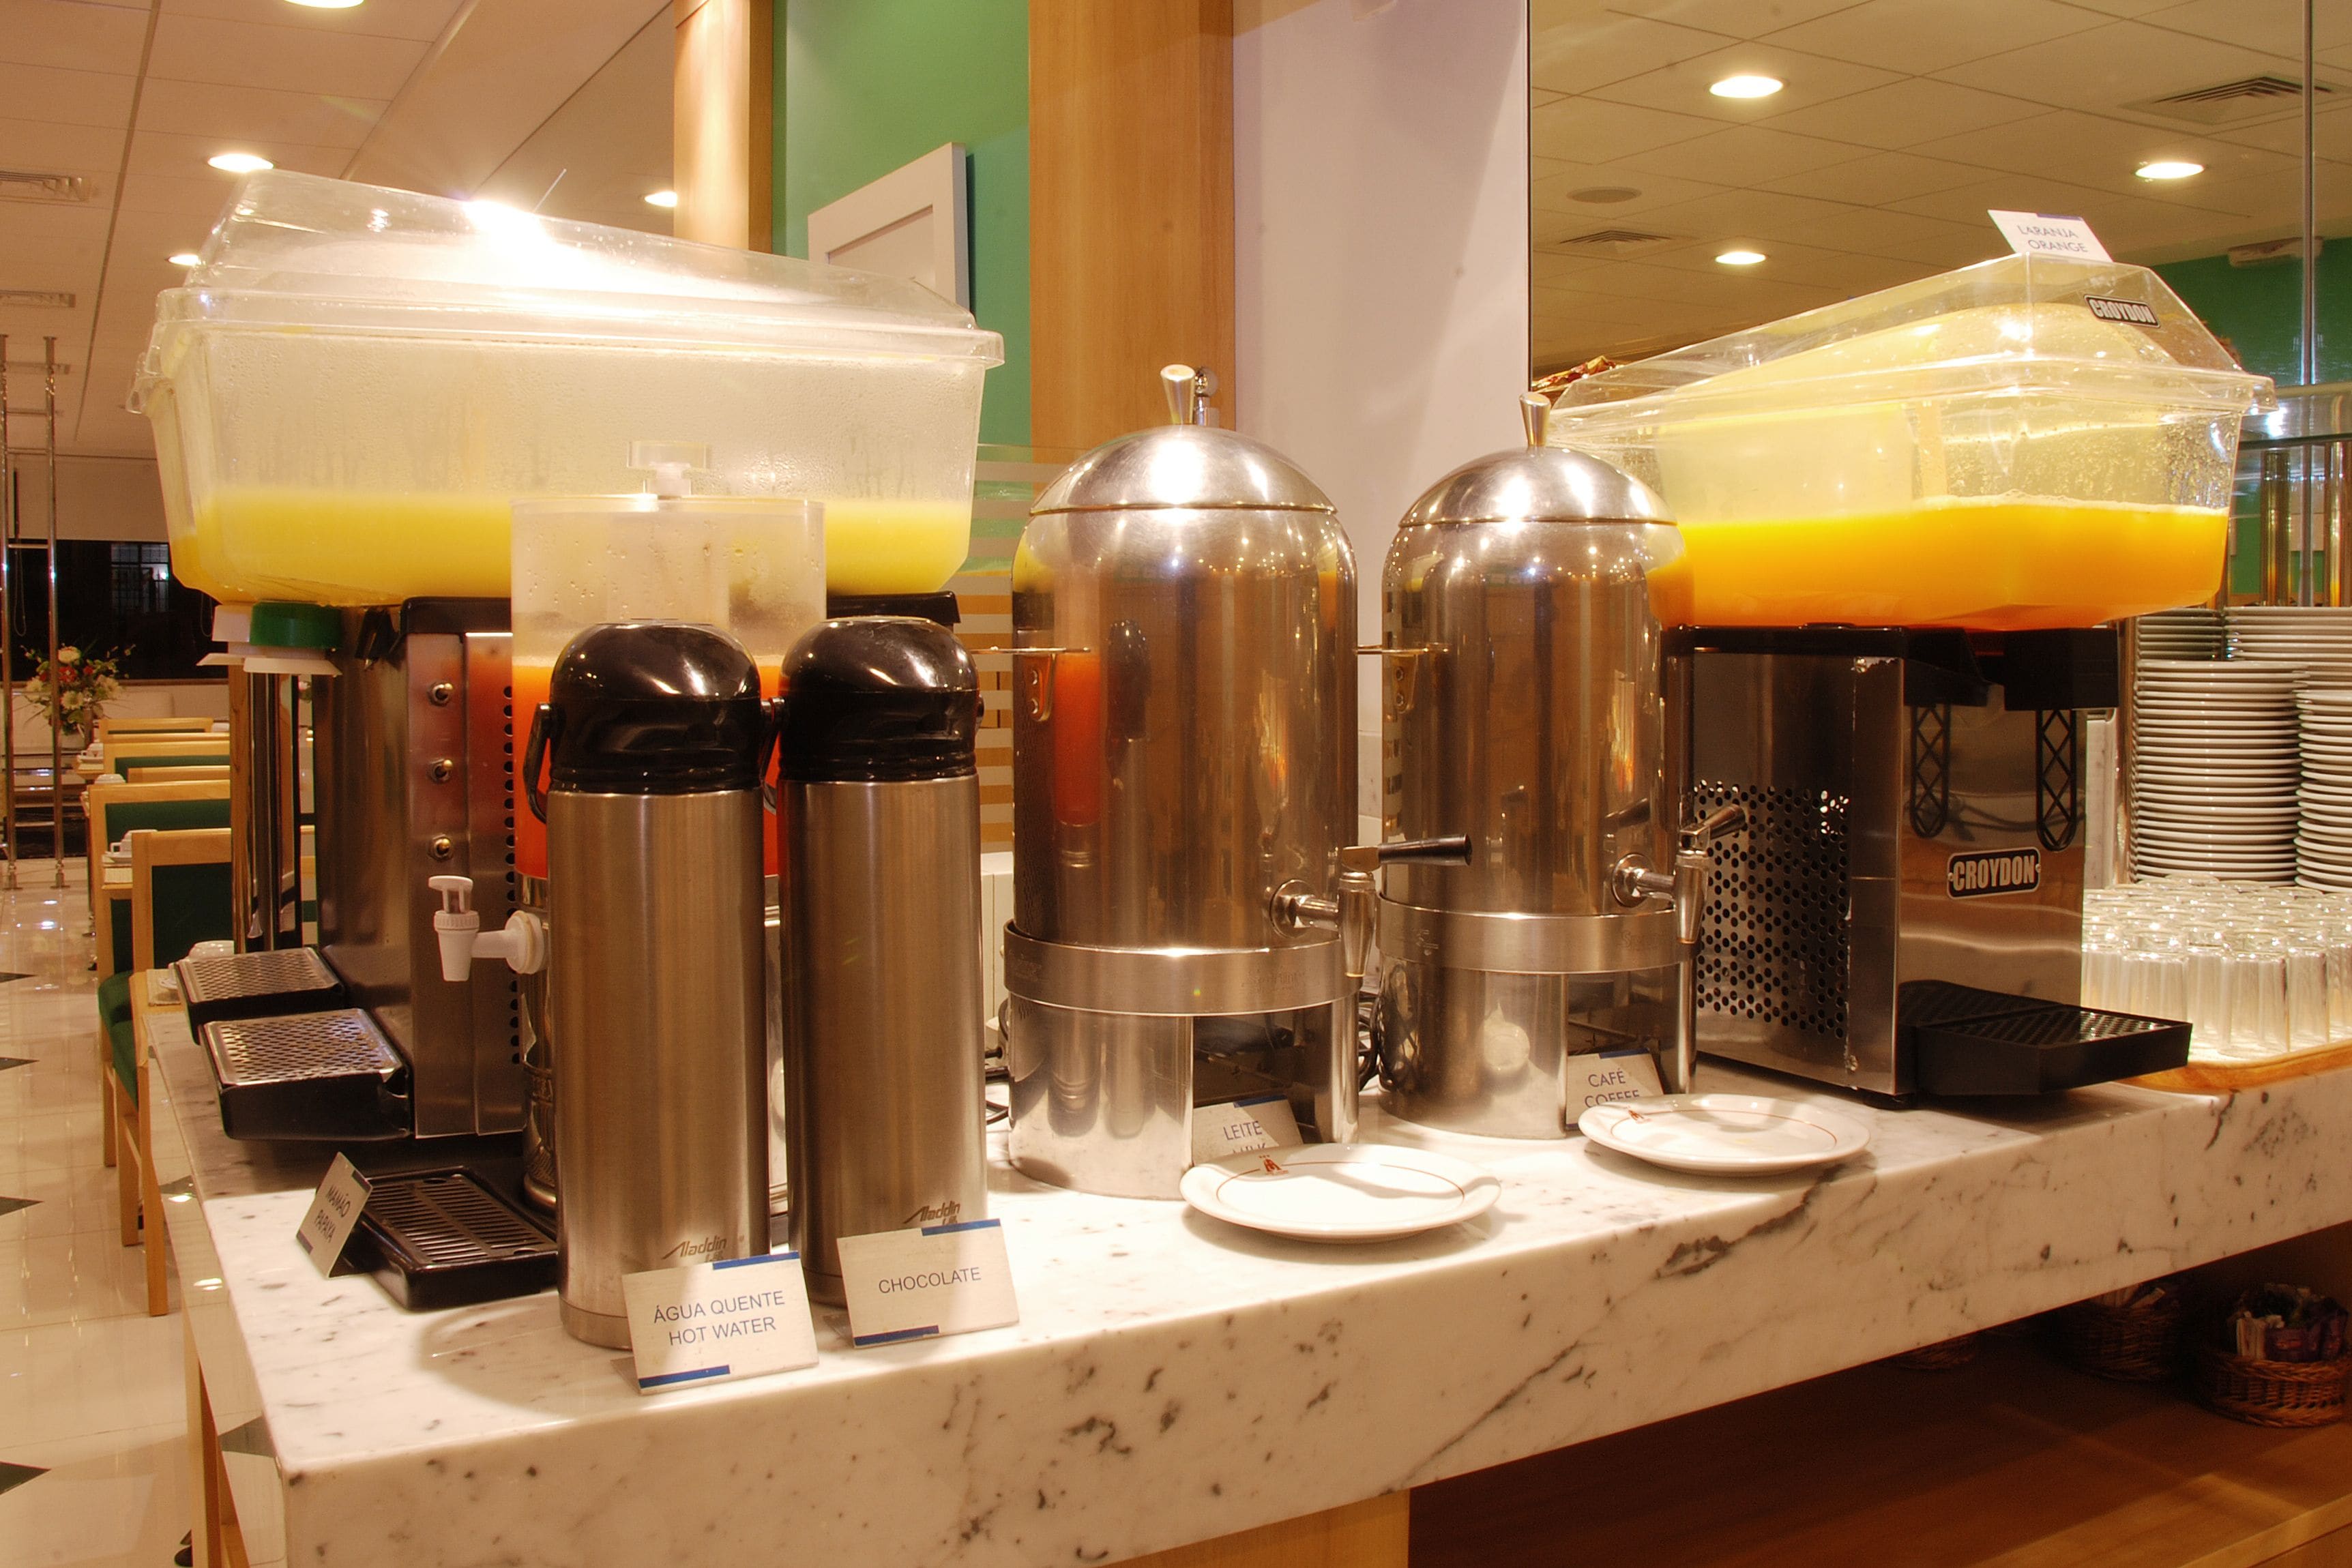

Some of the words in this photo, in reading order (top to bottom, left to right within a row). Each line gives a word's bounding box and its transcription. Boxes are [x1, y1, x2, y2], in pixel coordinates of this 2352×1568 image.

[2016, 225, 2078, 239] LARANJA
[2027, 239, 2089, 253] ORANGE
[2088, 297, 2157, 324] CROYDON
[1952, 855, 2035, 891] CROYDON
[1587, 1067, 1626, 1088] CAFÉ
[1223, 1120, 1263, 1141] LEITE
[325, 1185, 351, 1218] MAMÃO
[902, 1200, 960, 1224] Aladdin
[314, 1209, 337, 1244] PAPAYA
[661, 1234, 727, 1260] Aladdin
[878, 1267, 982, 1295] CHOCOLATE
[653, 1295, 707, 1325] ÁGUA
[711, 1290, 786, 1315] QUENTE
[668, 1326, 707, 1347] HOT
[711, 1315, 776, 1340] WATER
